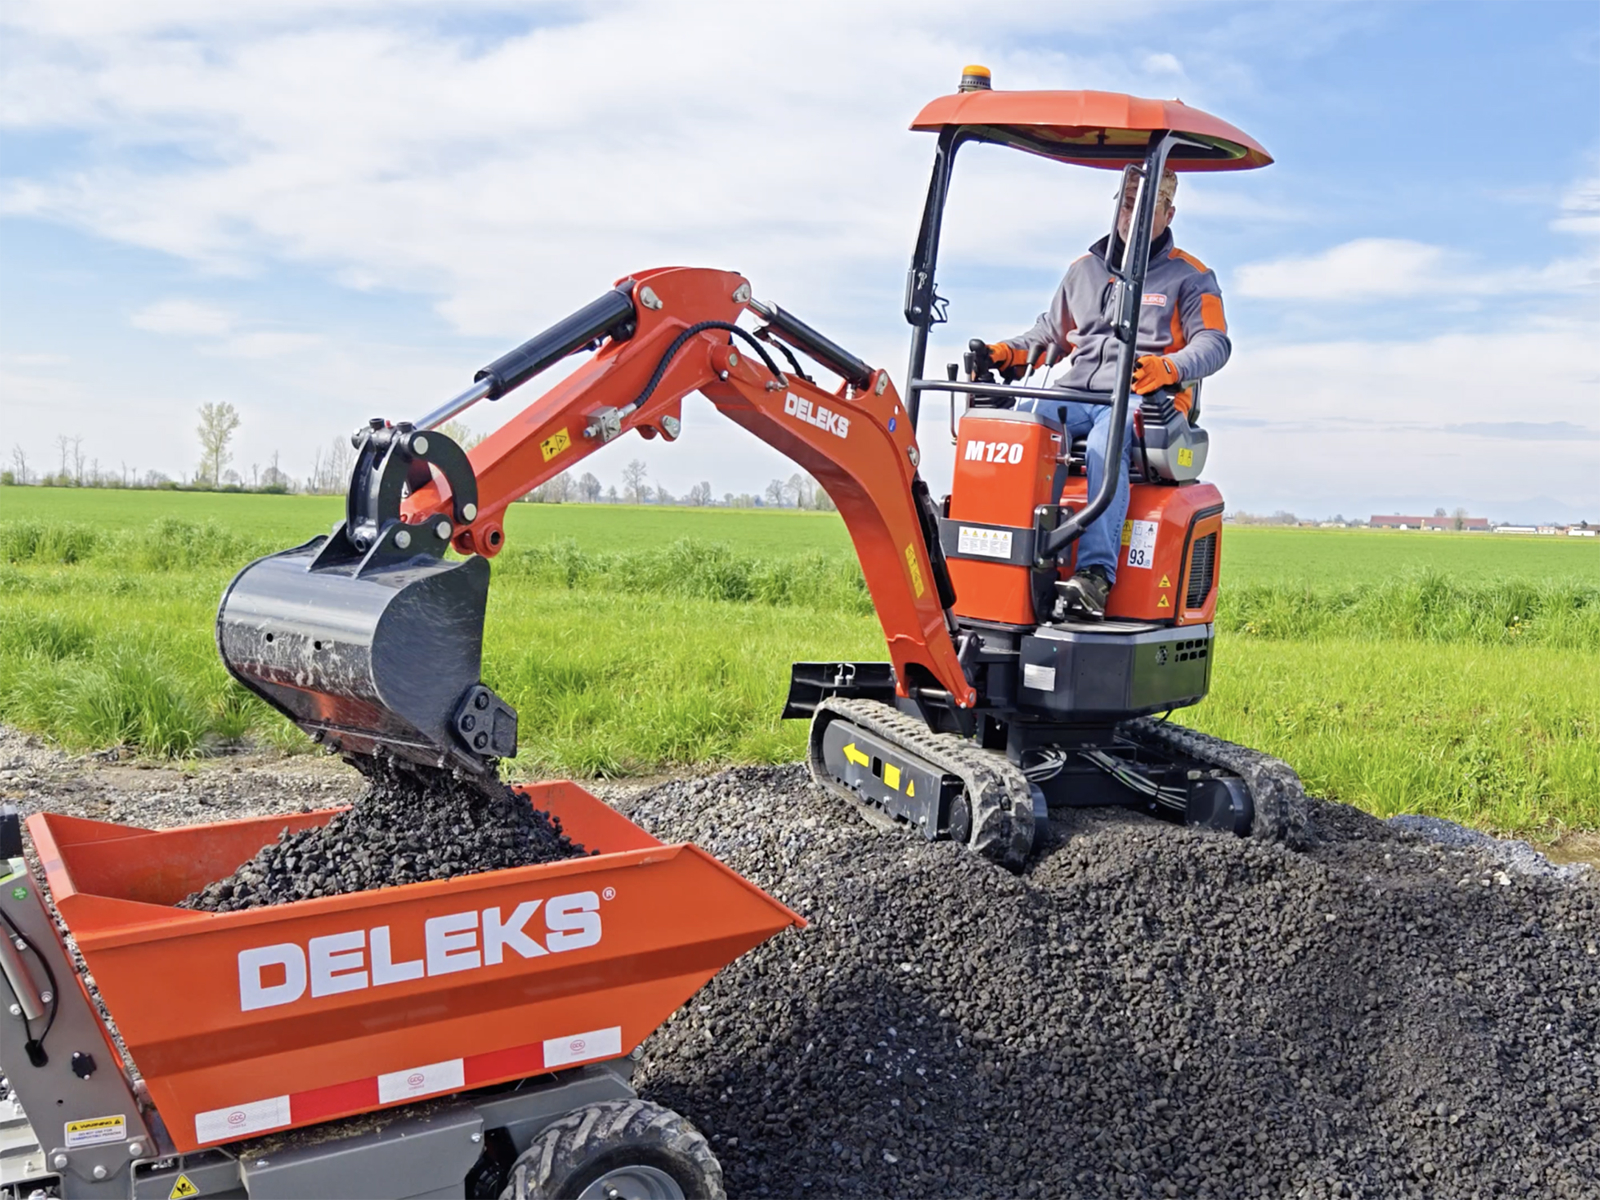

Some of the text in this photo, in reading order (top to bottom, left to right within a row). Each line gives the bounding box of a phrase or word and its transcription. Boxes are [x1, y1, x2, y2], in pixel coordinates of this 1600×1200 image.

[784, 391, 849, 439] DELEKS
[964, 440, 1024, 464] M120
[1129, 548, 1145, 566] 93
[238, 891, 602, 1012] DELEKS
